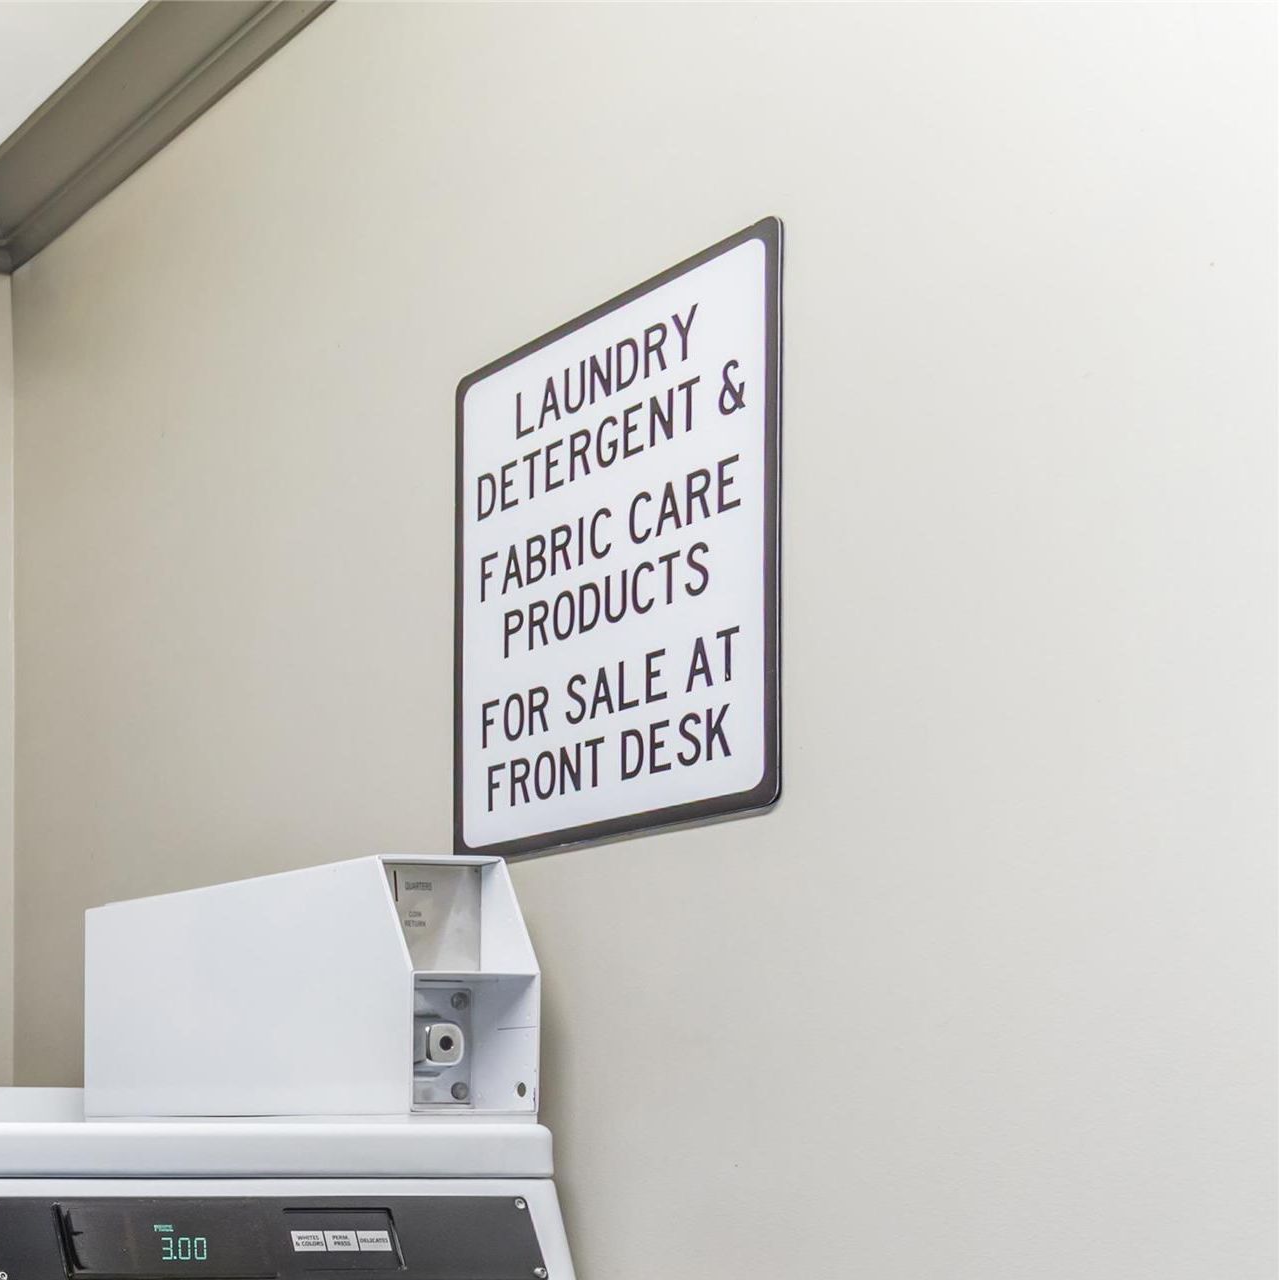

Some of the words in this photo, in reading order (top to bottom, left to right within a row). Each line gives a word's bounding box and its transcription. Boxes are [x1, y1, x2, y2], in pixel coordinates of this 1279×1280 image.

[517, 304, 697, 439] LAUNDRY
[478, 376, 700, 521] DETERGENT
[719, 360, 745, 415] &
[481, 508, 611, 602] FABRIC
[629, 454, 740, 544] CARE
[504, 542, 708, 658] PRODUCTS
[482, 687, 548, 748] FOR
[566, 649, 667, 724] SALE
[686, 626, 739, 692] AT
[488, 736, 604, 812] FRONT
[621, 704, 731, 781] DESK
[405, 881, 432, 890] QUARTERS
[161, 1237, 207, 1260] 3.00
